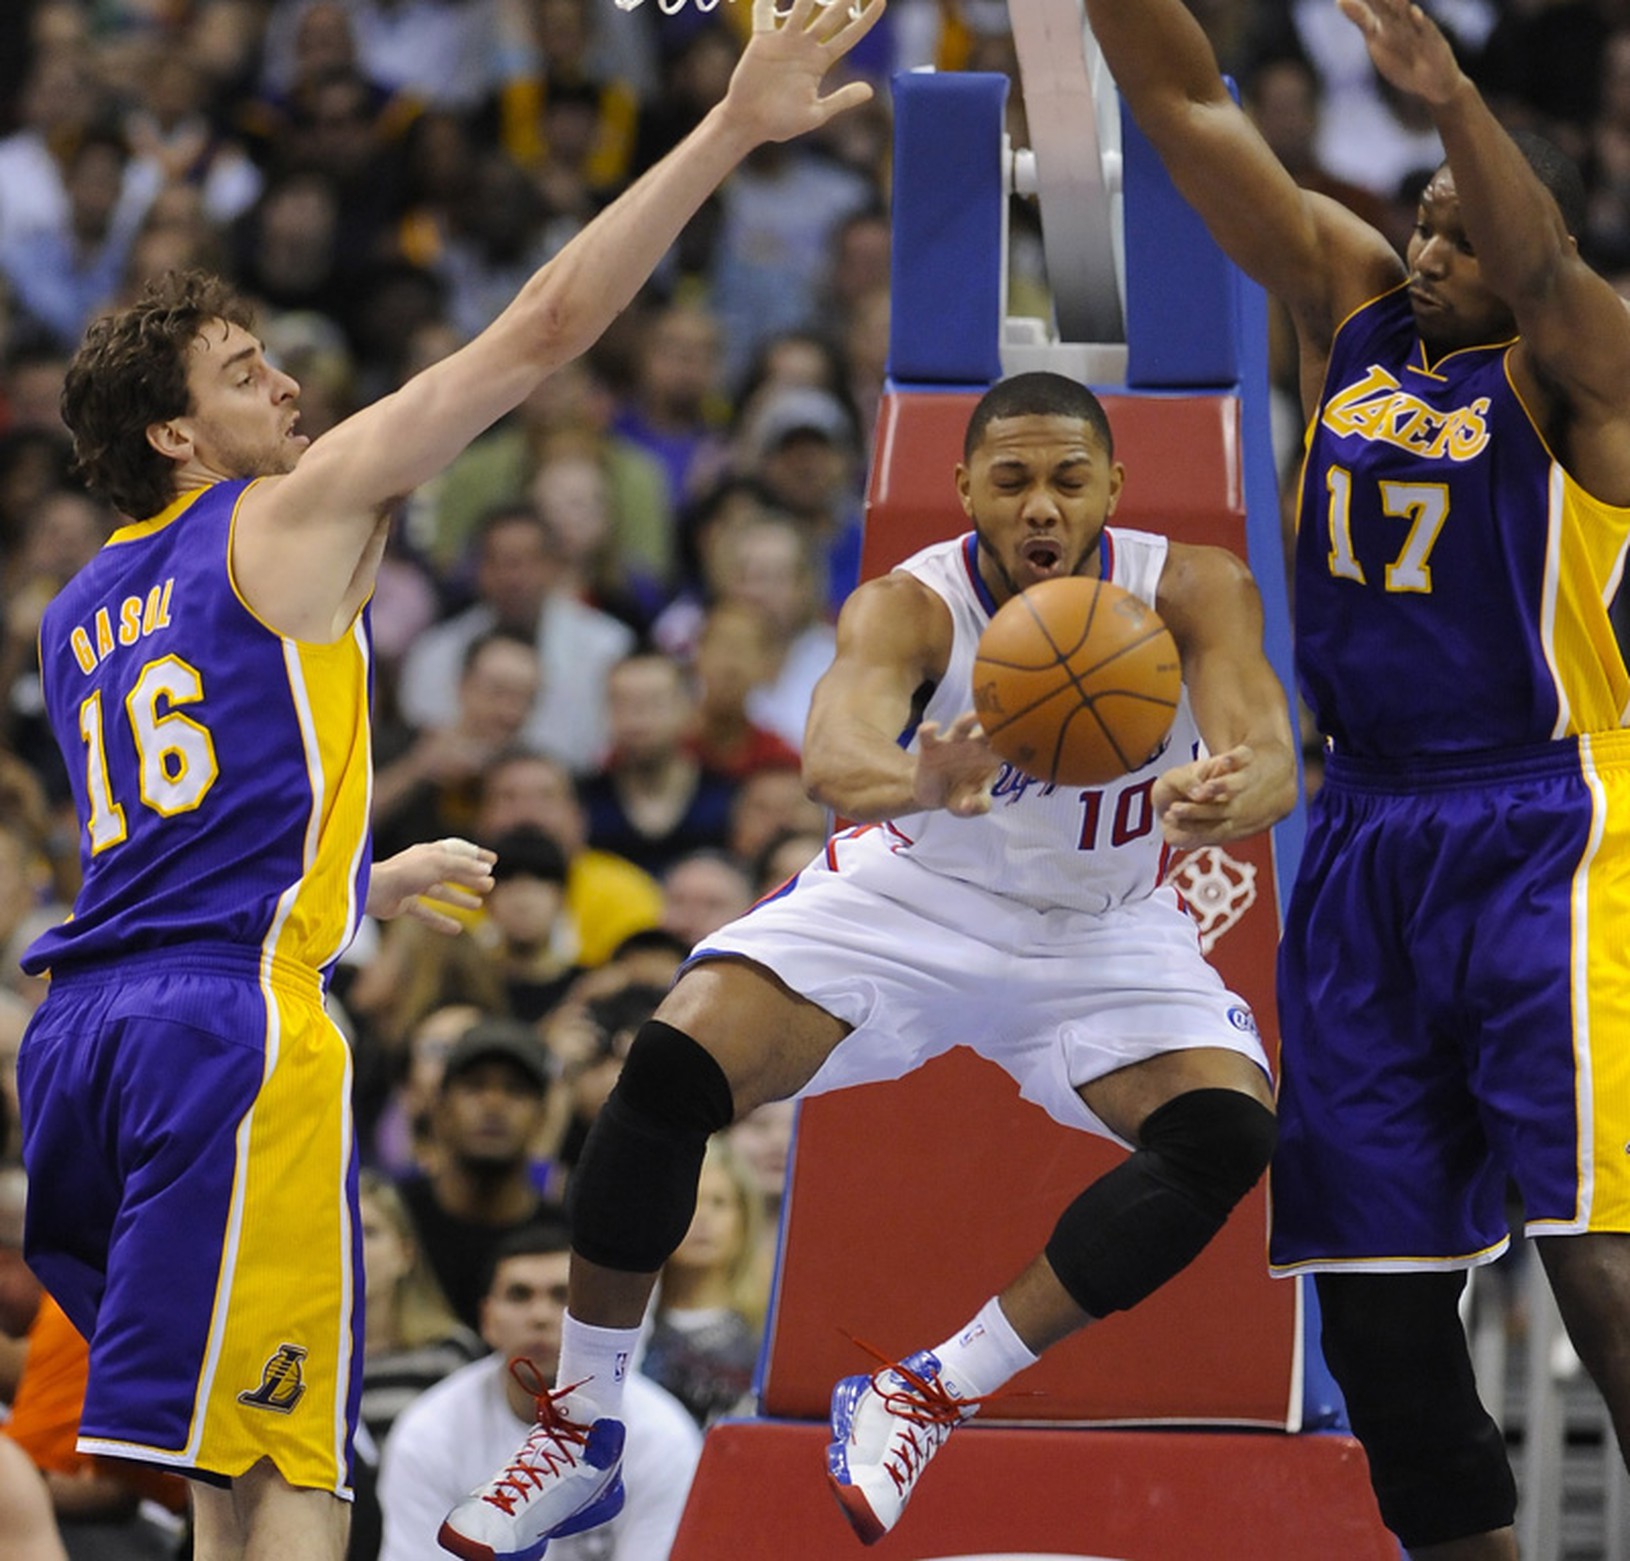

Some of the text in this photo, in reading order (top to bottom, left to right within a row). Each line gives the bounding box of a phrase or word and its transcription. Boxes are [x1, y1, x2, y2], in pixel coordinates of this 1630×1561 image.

[1321, 364, 1491, 461] LAKERS
[1326, 464, 1450, 593] 17
[70, 577, 174, 675] GASOL
[79, 653, 219, 857] 16
[1077, 776, 1158, 851] 10
